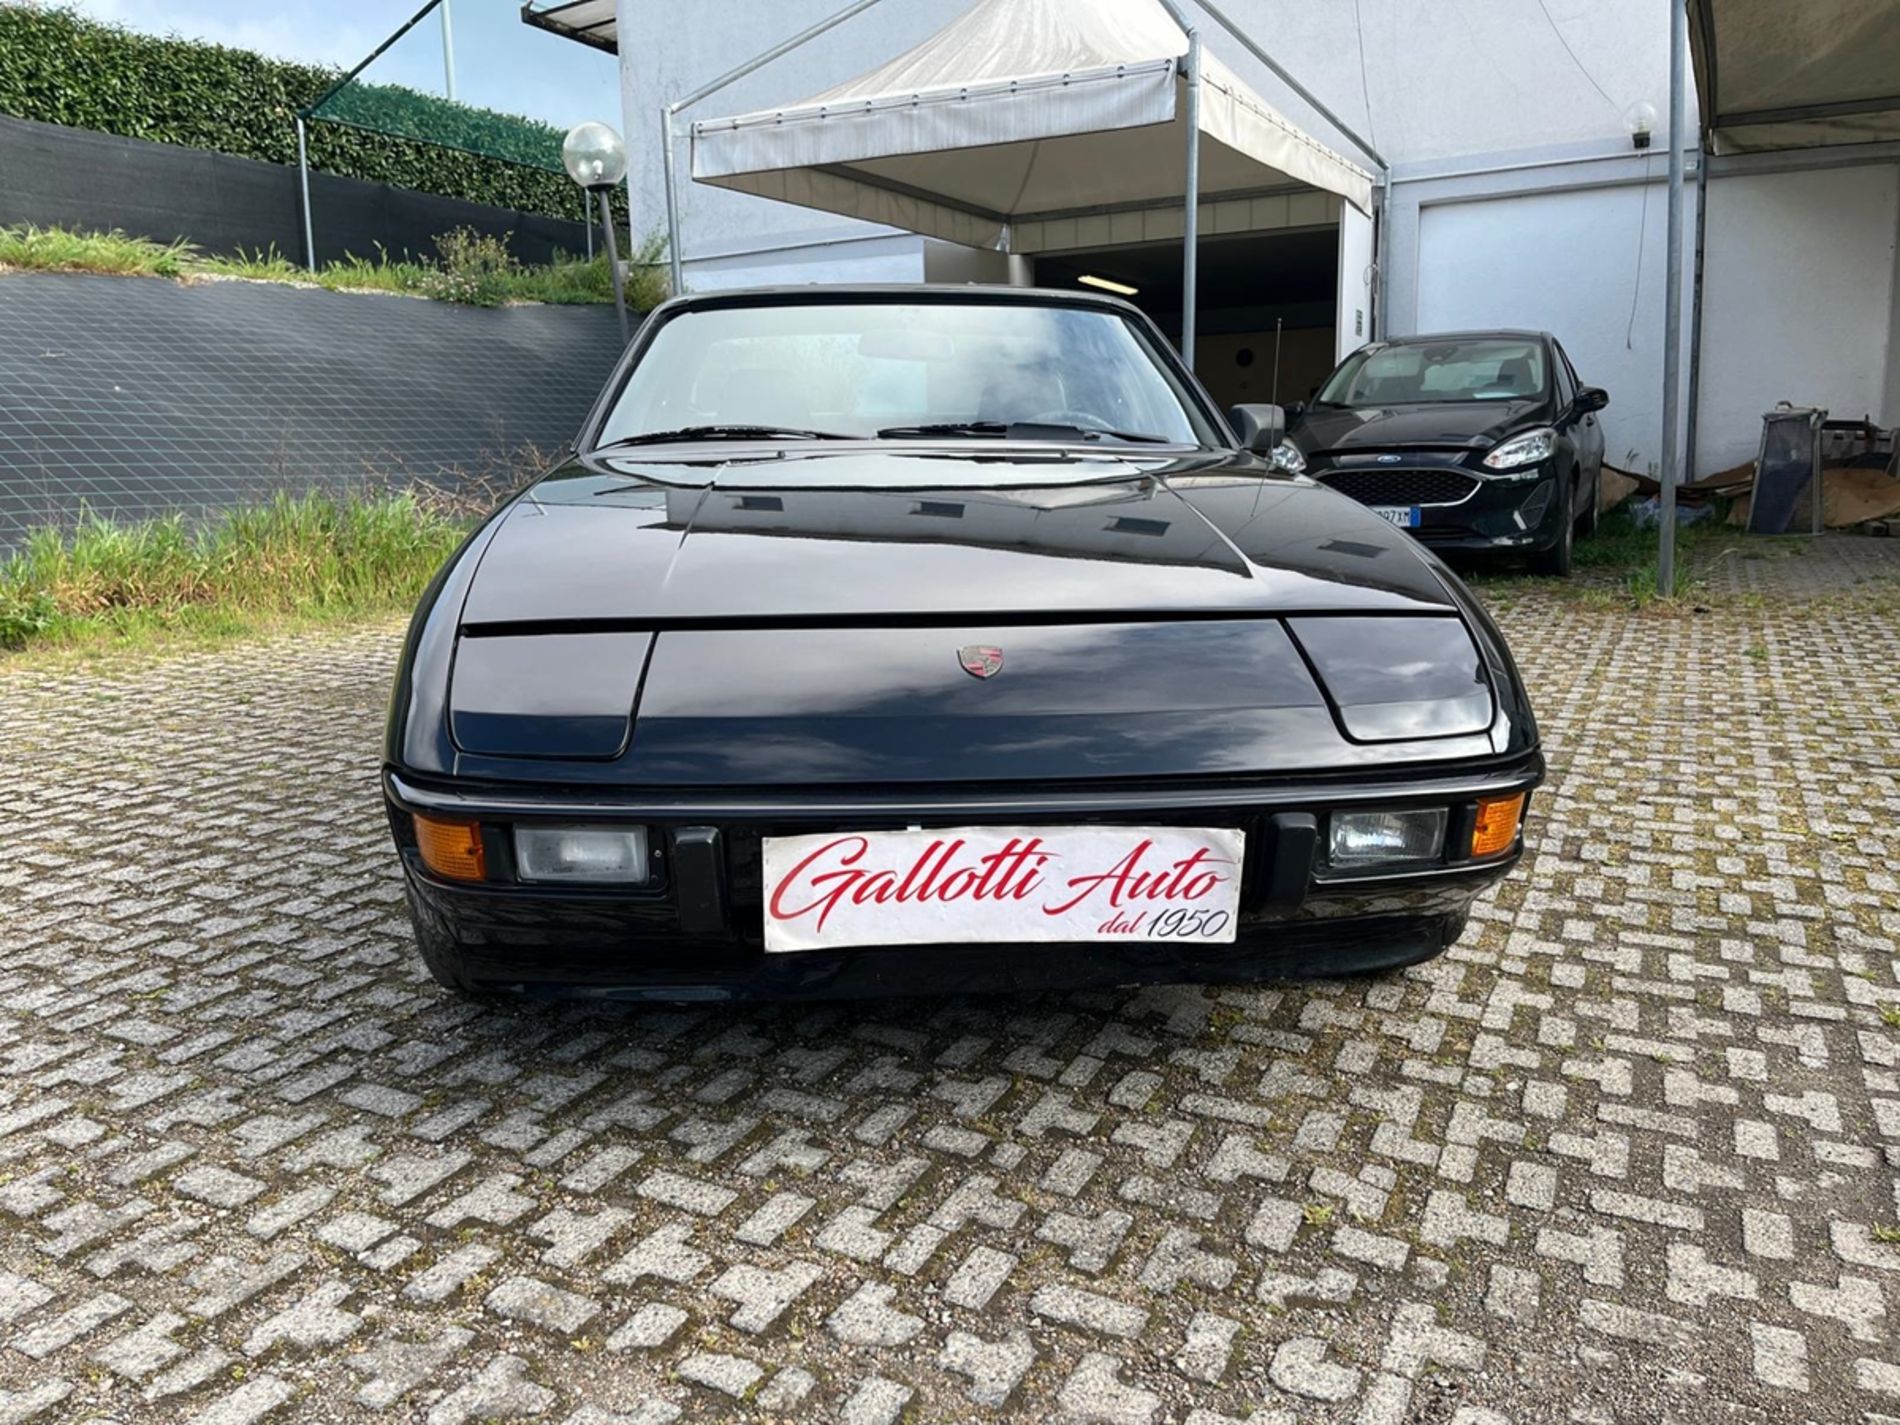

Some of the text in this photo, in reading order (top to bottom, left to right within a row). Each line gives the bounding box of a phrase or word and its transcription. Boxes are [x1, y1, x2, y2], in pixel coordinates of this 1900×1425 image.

[769, 836, 1238, 933] Gallotti Auto
[1097, 908, 1230, 937] dal 1950
